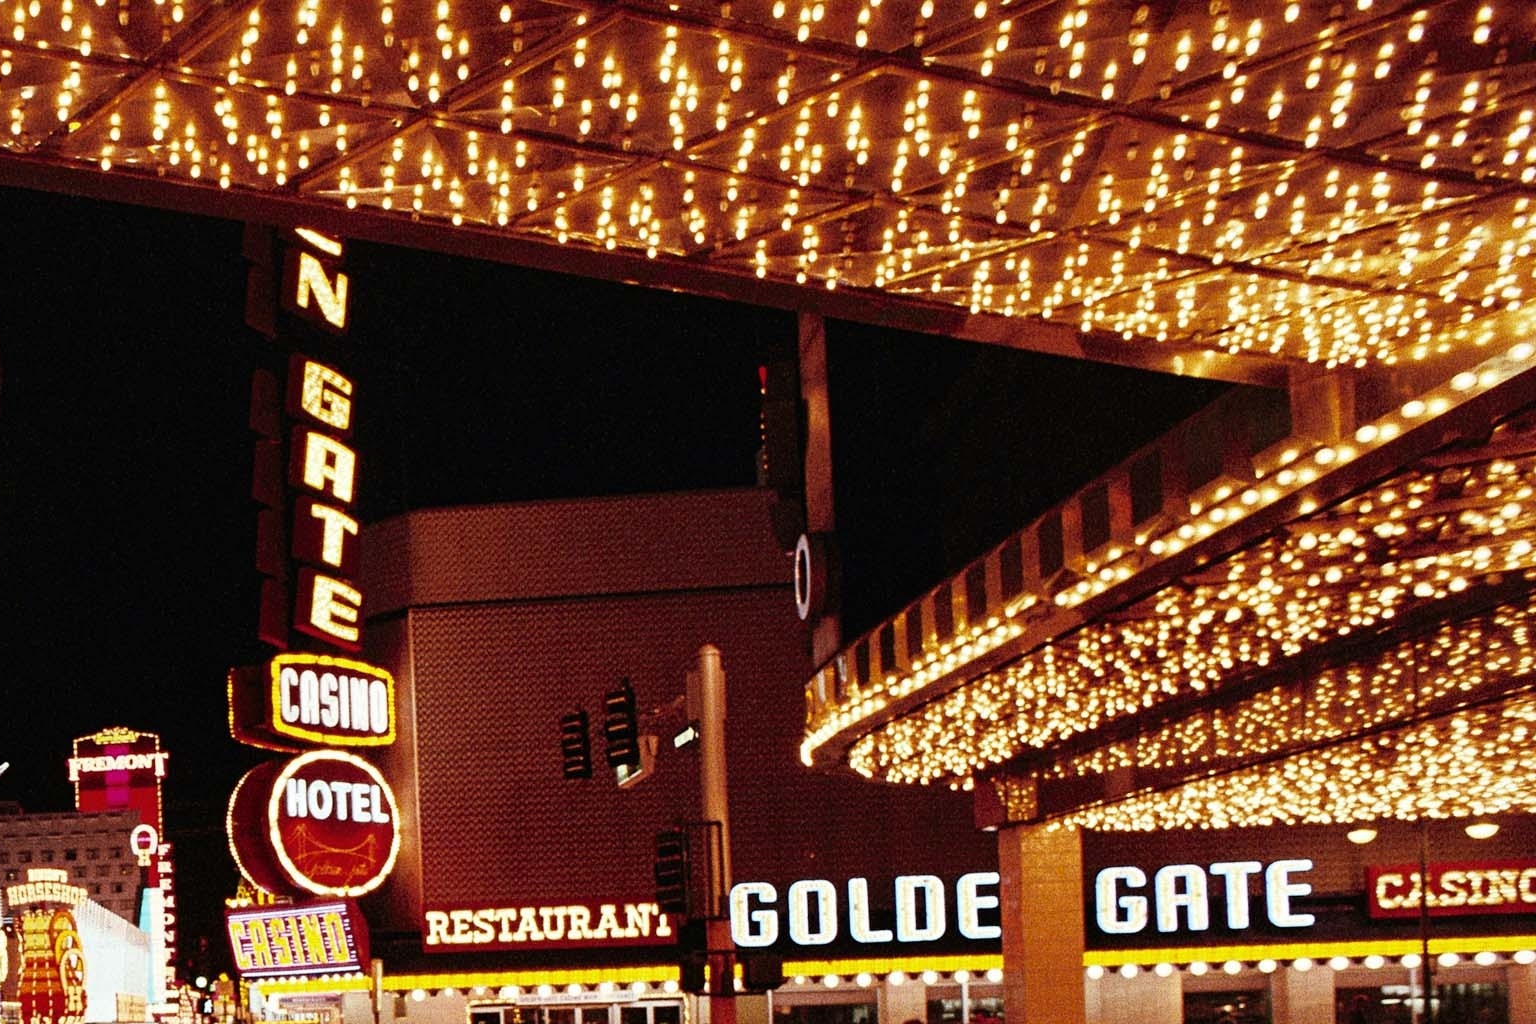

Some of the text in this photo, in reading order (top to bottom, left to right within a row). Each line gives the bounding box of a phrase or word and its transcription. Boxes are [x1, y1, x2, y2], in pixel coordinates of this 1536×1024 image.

[302, 361, 362, 642] GATE
[279, 667, 389, 735] CASINO
[68, 753, 169, 781] FREMONT
[286, 779, 390, 823] HOTEL
[7, 883, 88, 906] HORSESHOE
[729, 858, 1315, 948] GOLDE GATE
[228, 912, 351, 970] CASINO
